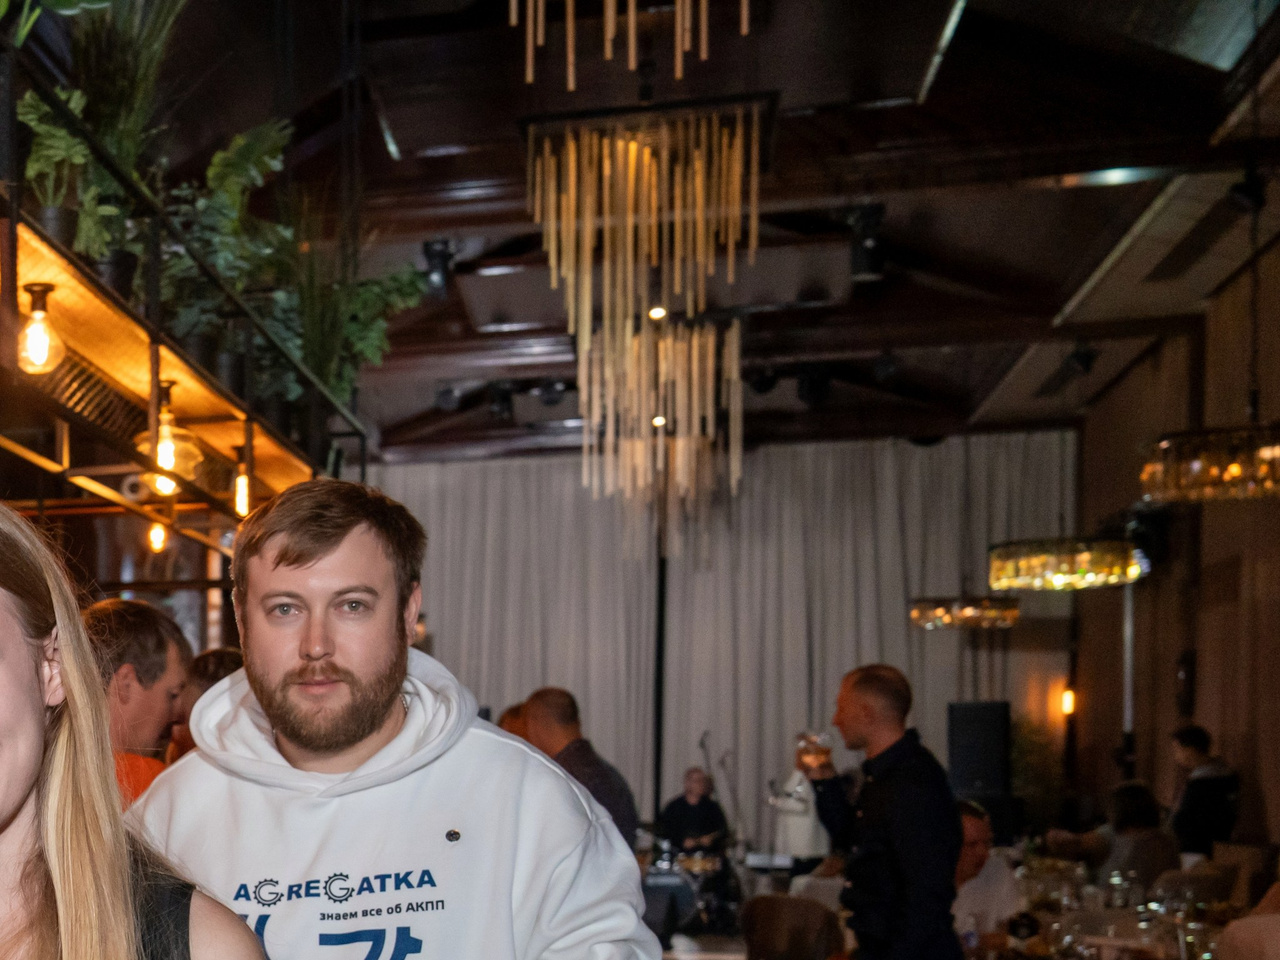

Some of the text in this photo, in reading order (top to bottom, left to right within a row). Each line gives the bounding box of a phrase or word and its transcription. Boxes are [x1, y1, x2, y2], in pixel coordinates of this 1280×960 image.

[233, 869, 437, 907] AGREGATKA
[319, 900, 445, 921] знаем все об АКПП
